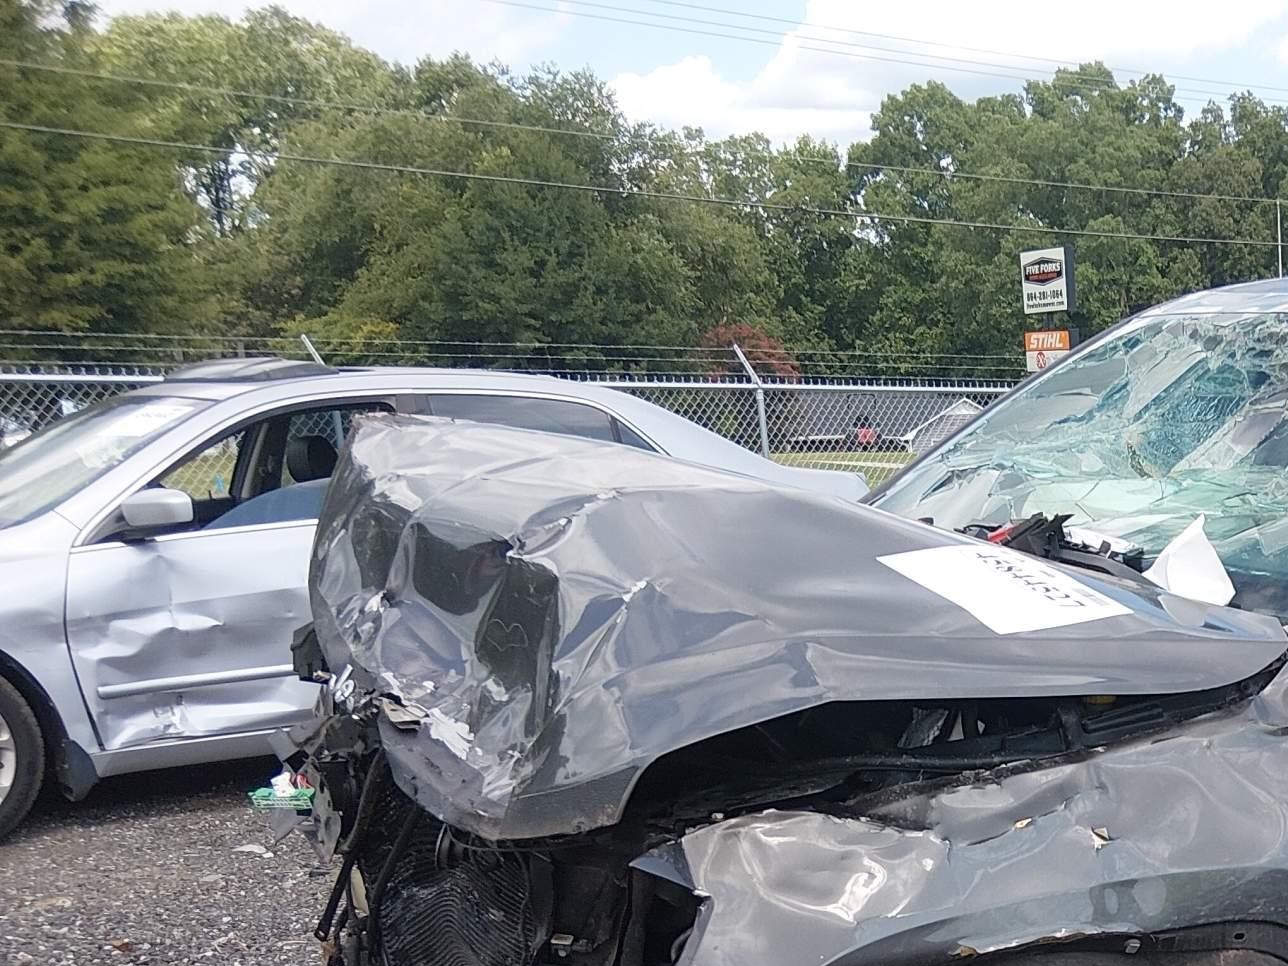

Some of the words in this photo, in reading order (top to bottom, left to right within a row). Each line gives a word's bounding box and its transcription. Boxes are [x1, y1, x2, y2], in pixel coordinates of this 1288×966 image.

[1026, 264, 1040, 276] FIVE
[1040, 262, 1061, 273] FORKS
[1029, 333, 1064, 349] STIHL
